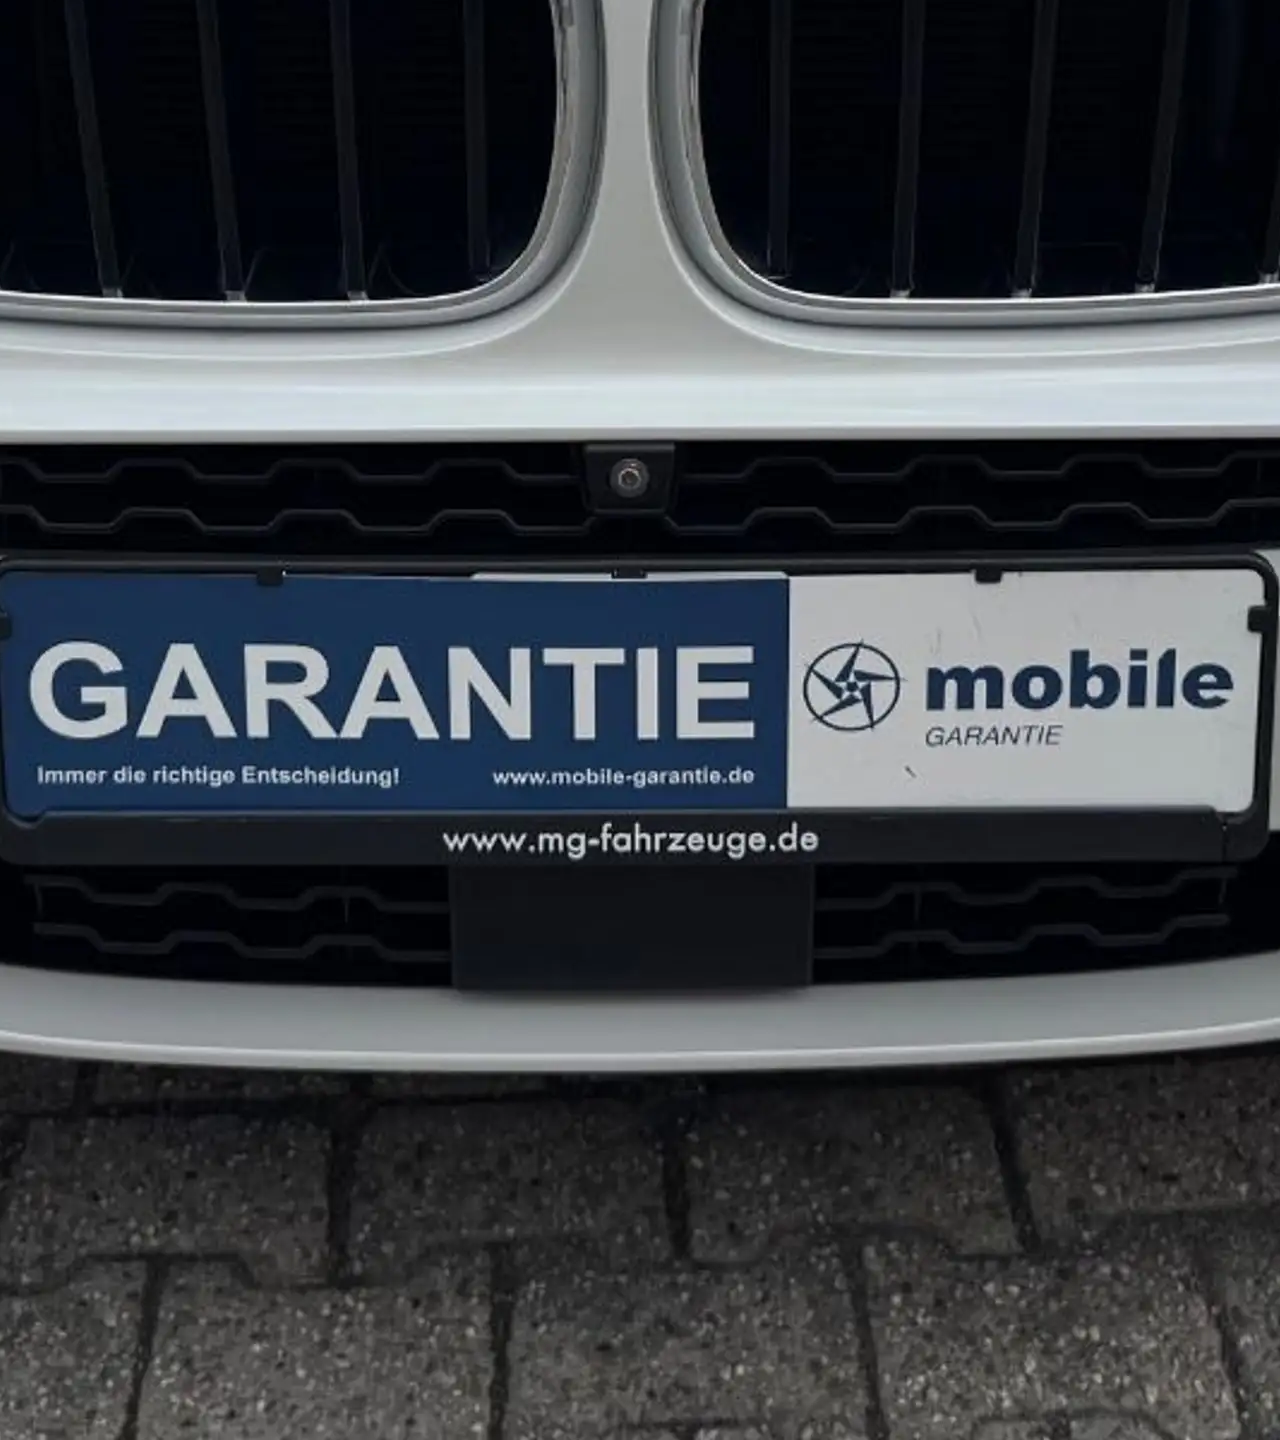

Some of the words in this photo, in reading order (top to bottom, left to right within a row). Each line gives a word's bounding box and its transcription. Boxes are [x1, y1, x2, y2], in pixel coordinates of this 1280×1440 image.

[29, 641, 756, 739] GARANTIE
[926, 648, 1235, 710] mobile
[925, 723, 1064, 748] GARANTIE
[36, 766, 106, 785] Immer
[113, 765, 146, 785] die
[152, 765, 235, 789] richtige
[241, 766, 400, 789] Entscheidung!
[492, 765, 756, 789] www.mobile-garantie.de
[442, 821, 820, 860] www.mg-fahrzeuge.de
